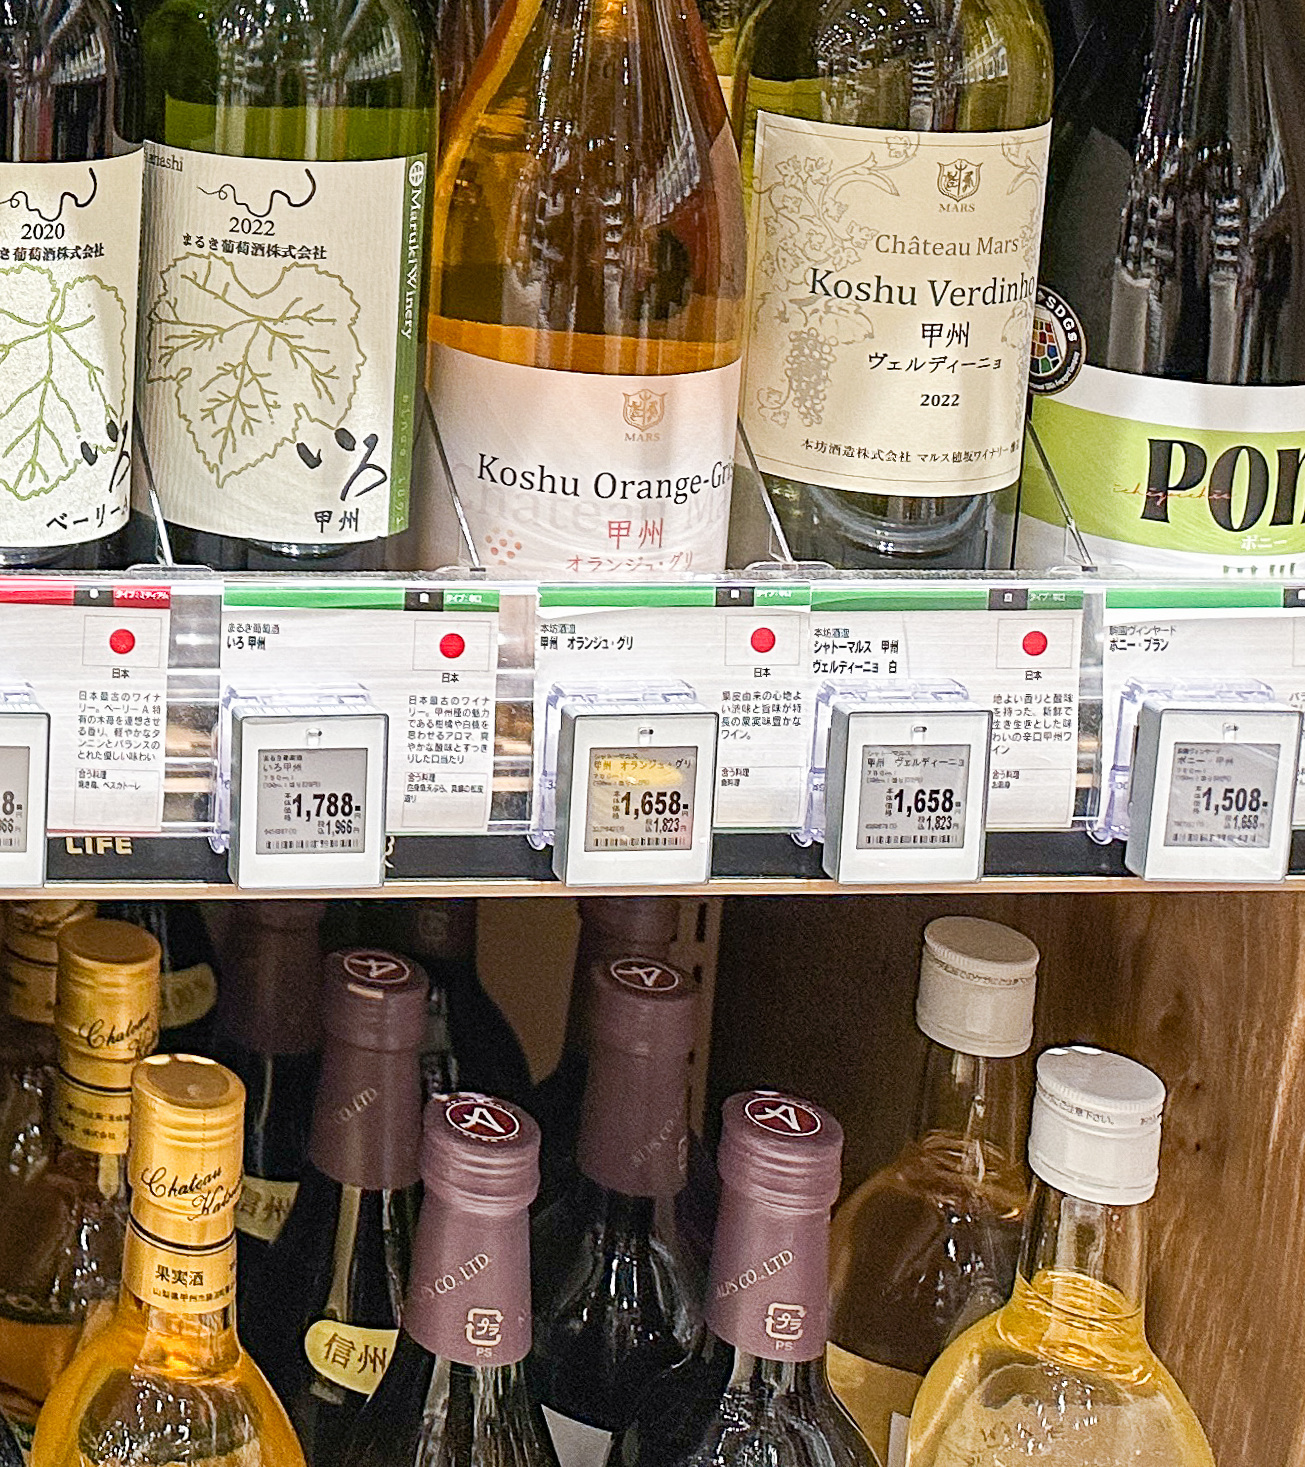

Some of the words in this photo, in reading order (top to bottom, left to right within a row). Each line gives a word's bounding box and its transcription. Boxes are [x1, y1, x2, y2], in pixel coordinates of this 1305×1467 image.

[21, 223, 65, 240] 2020
[229, 216, 276, 237] 2022
[182, 234, 327, 260] まるき葡萄酒株式会社
[875, 233, 971, 257] Château
[976, 236, 1019, 255] Mars
[809, 267, 917, 306] Koshu
[928, 273, 1035, 307] Verdinho
[868, 352, 1002, 374] ヴェルディーニョ
[920, 393, 960, 407] 2022
[624, 433, 660, 442] MARS
[295, 427, 387, 501] いろ
[314, 507, 359, 533] 甲州
[608, 518, 664, 549] 甲州
[1109, 638, 1169, 652] ポニー・ブラン
[292, 792, 353, 822] 1,788
[620, 791, 681, 819] 1,658
[893, 789, 954, 817] 1,658
[65, 837, 133, 854] LIFE
[154, 1264, 205, 1289] 果実酒
[323, 1331, 388, 1376] 信州
[775, 1340, 794, 1352] PS
